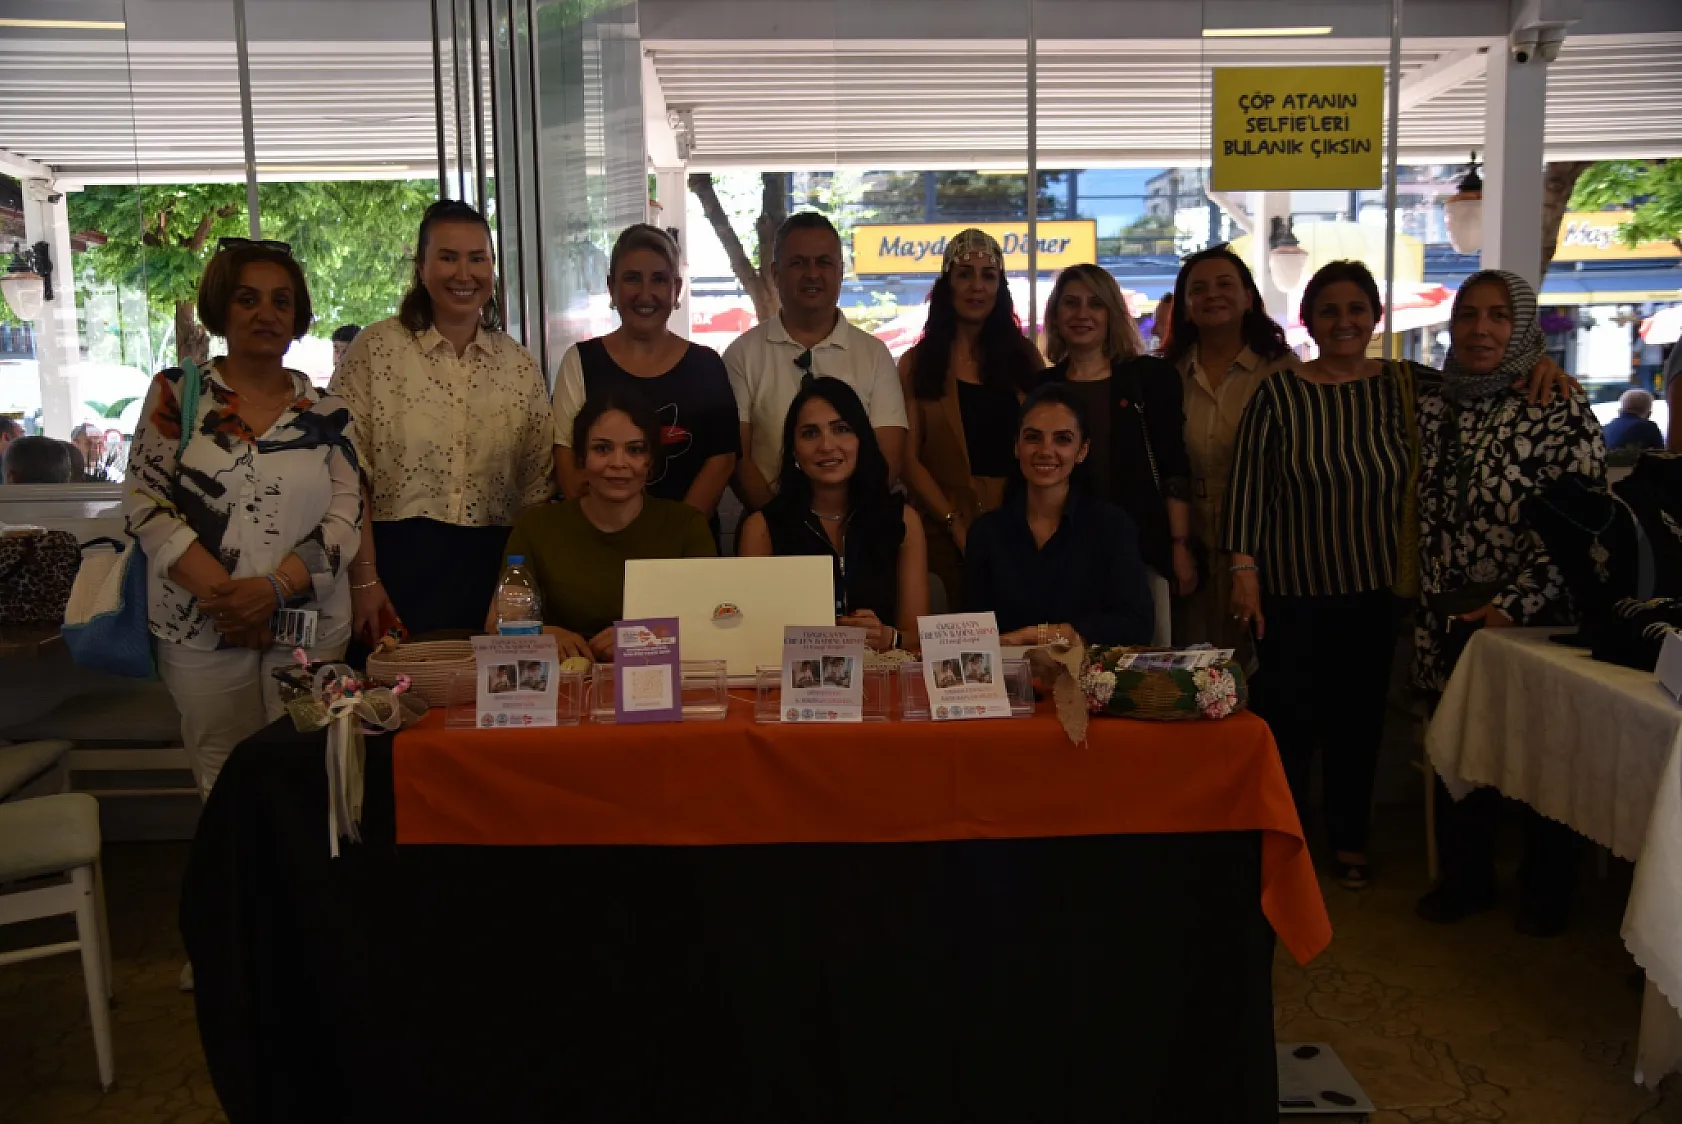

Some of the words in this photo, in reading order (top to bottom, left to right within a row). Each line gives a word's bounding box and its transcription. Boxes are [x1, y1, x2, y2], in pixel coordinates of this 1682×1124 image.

[1238, 90, 1275, 114] ÇÖP
[1282, 93, 1358, 110] ATANIN
[1223, 138, 1304, 156] BULANIK
[1310, 137, 1372, 159] ÇIKSIN
[878, 235, 947, 262] Mayd
[1002, 232, 1072, 255] Döner
